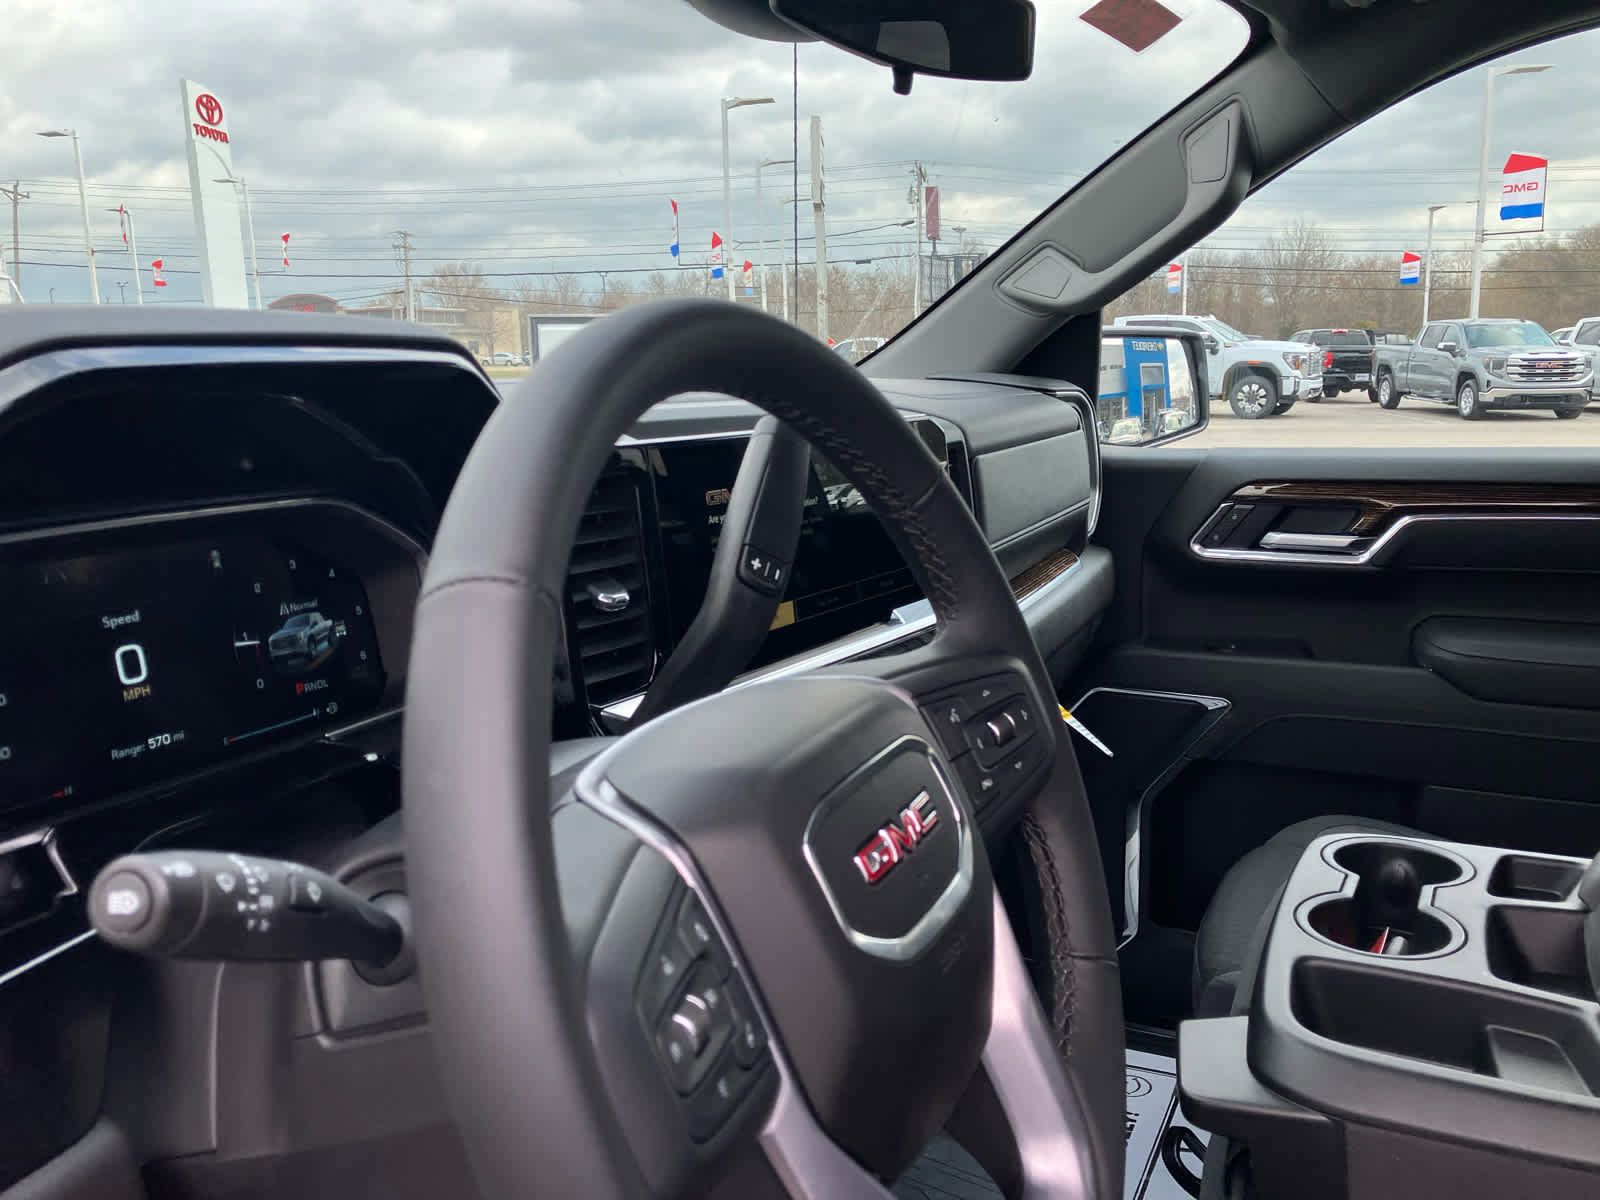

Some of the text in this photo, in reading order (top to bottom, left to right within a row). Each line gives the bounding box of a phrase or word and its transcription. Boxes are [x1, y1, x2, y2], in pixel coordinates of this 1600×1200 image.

[192, 123, 230, 144] TOYOTA
[101, 609, 141, 629] Speed
[114, 643, 148, 685] 0
[122, 684, 152, 703] MPH
[147, 733, 171, 750] 570
[852, 790, 941, 884] GMC
